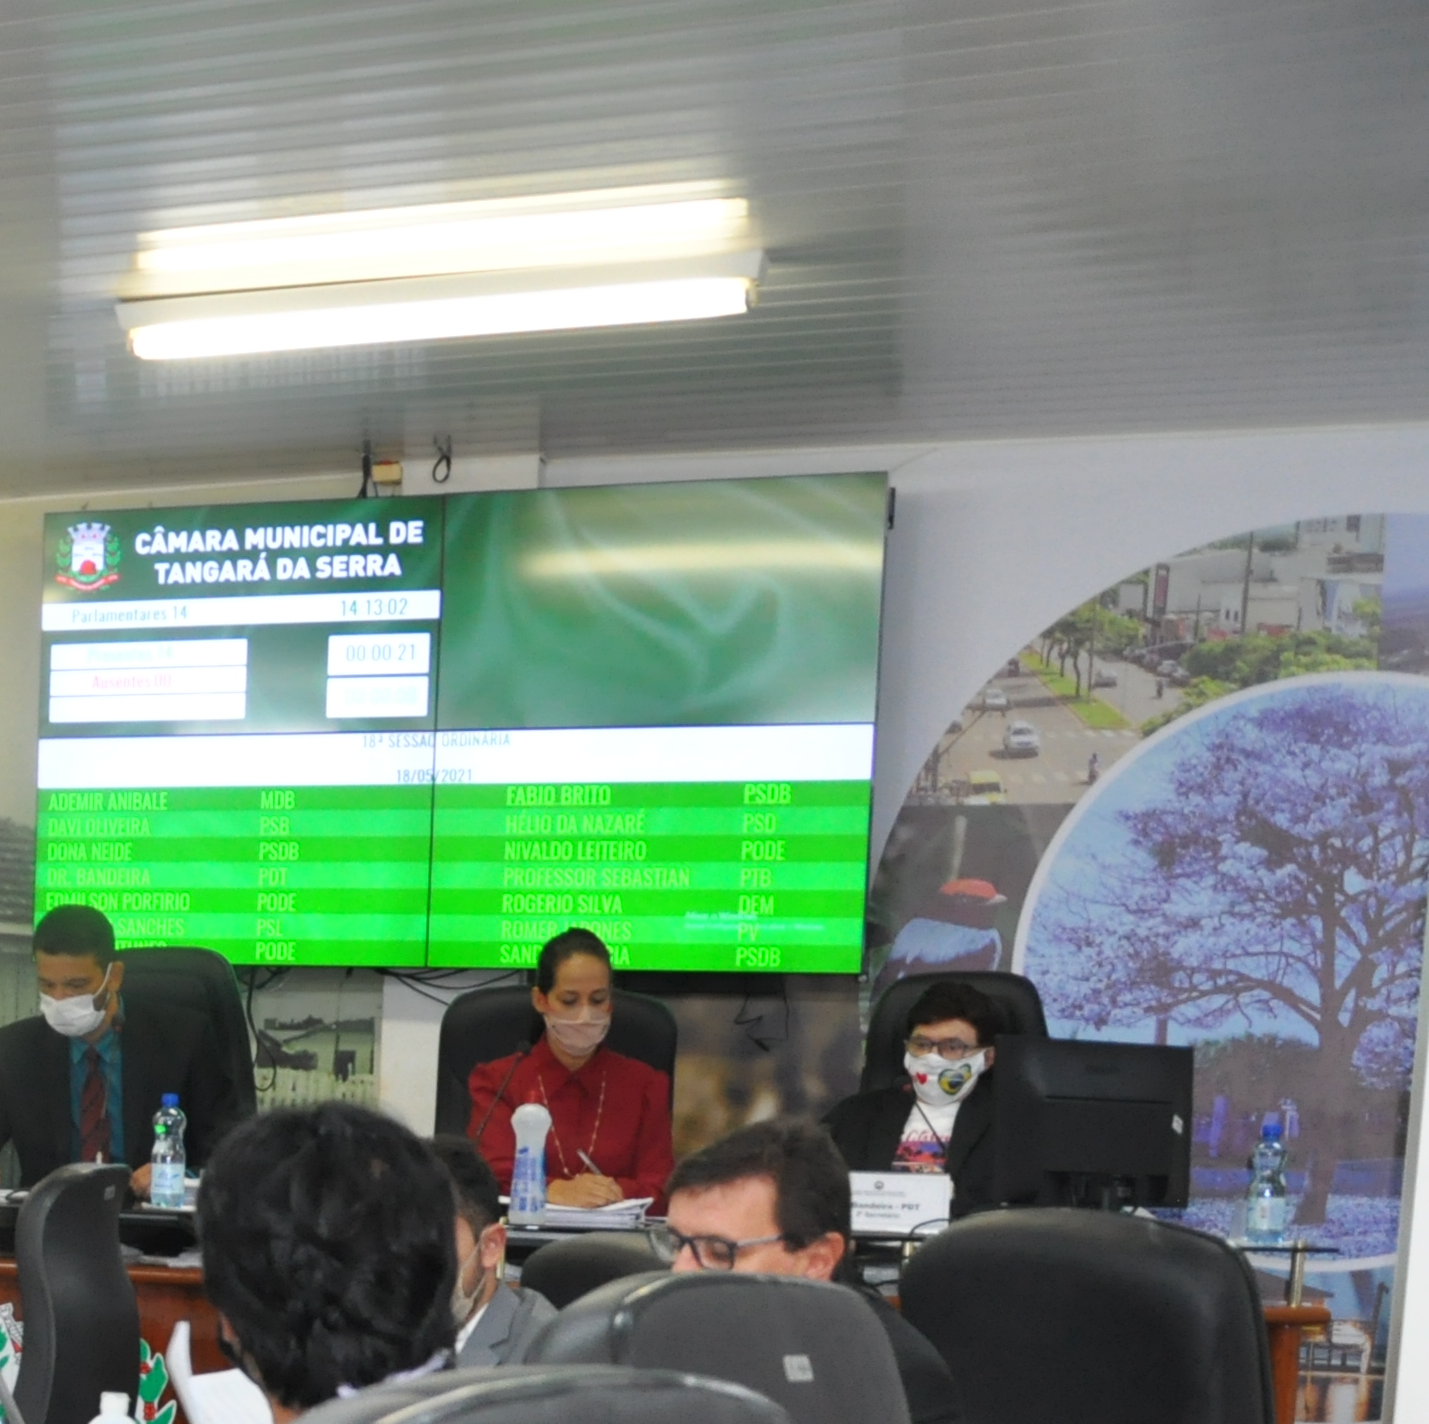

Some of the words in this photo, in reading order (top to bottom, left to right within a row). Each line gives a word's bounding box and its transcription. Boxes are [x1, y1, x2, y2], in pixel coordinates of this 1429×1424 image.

[135, 526, 240, 555] CÂMARA
[245, 523, 383, 551] MUNICIPAL
[389, 521, 424, 544] DE
[155, 552, 271, 584] TANGARÁ
[276, 556, 311, 580] DA
[316, 554, 402, 578] SERRA
[72, 607, 167, 624] Parlamentares
[48, 792, 104, 811] ADEMIR
[107, 791, 168, 811] ANIBALE
[260, 790, 296, 810] MDB
[507, 786, 556, 806] FABIO
[561, 785, 611, 805] BRITO
[744, 783, 791, 804] PSDB
[48, 818, 82, 837] DAVI
[86, 817, 151, 836] OLIVEIRA
[260, 816, 290, 836] PSB
[557, 814, 578, 834] DA
[743, 813, 776, 834] PSD
[47, 842, 88, 862] DONA
[91, 842, 132, 861] NEIDE
[259, 841, 299, 861] PSDB
[504, 841, 573, 861] NIVALDO
[578, 840, 647, 861] LEITEIRO
[741, 840, 786, 861] PODE
[47, 868, 71, 886] DR.
[76, 867, 151, 886] BANDEIRA
[258, 867, 289, 886] PDT
[504, 867, 597, 887] PROFESSOR
[601, 867, 690, 887] SEBASTIAN
[740, 868, 772, 887] PTB
[121, 891, 191, 911] PORFIRIO
[257, 893, 296, 912] PODE
[577, 894, 623, 914] SILVA
[738, 895, 774, 915] DEM
[117, 918, 185, 936] SANCHES
[256, 918, 283, 937] PSL
[738, 922, 758, 941] PV
[255, 941, 296, 960] PODE
[735, 947, 781, 967] PSDB
